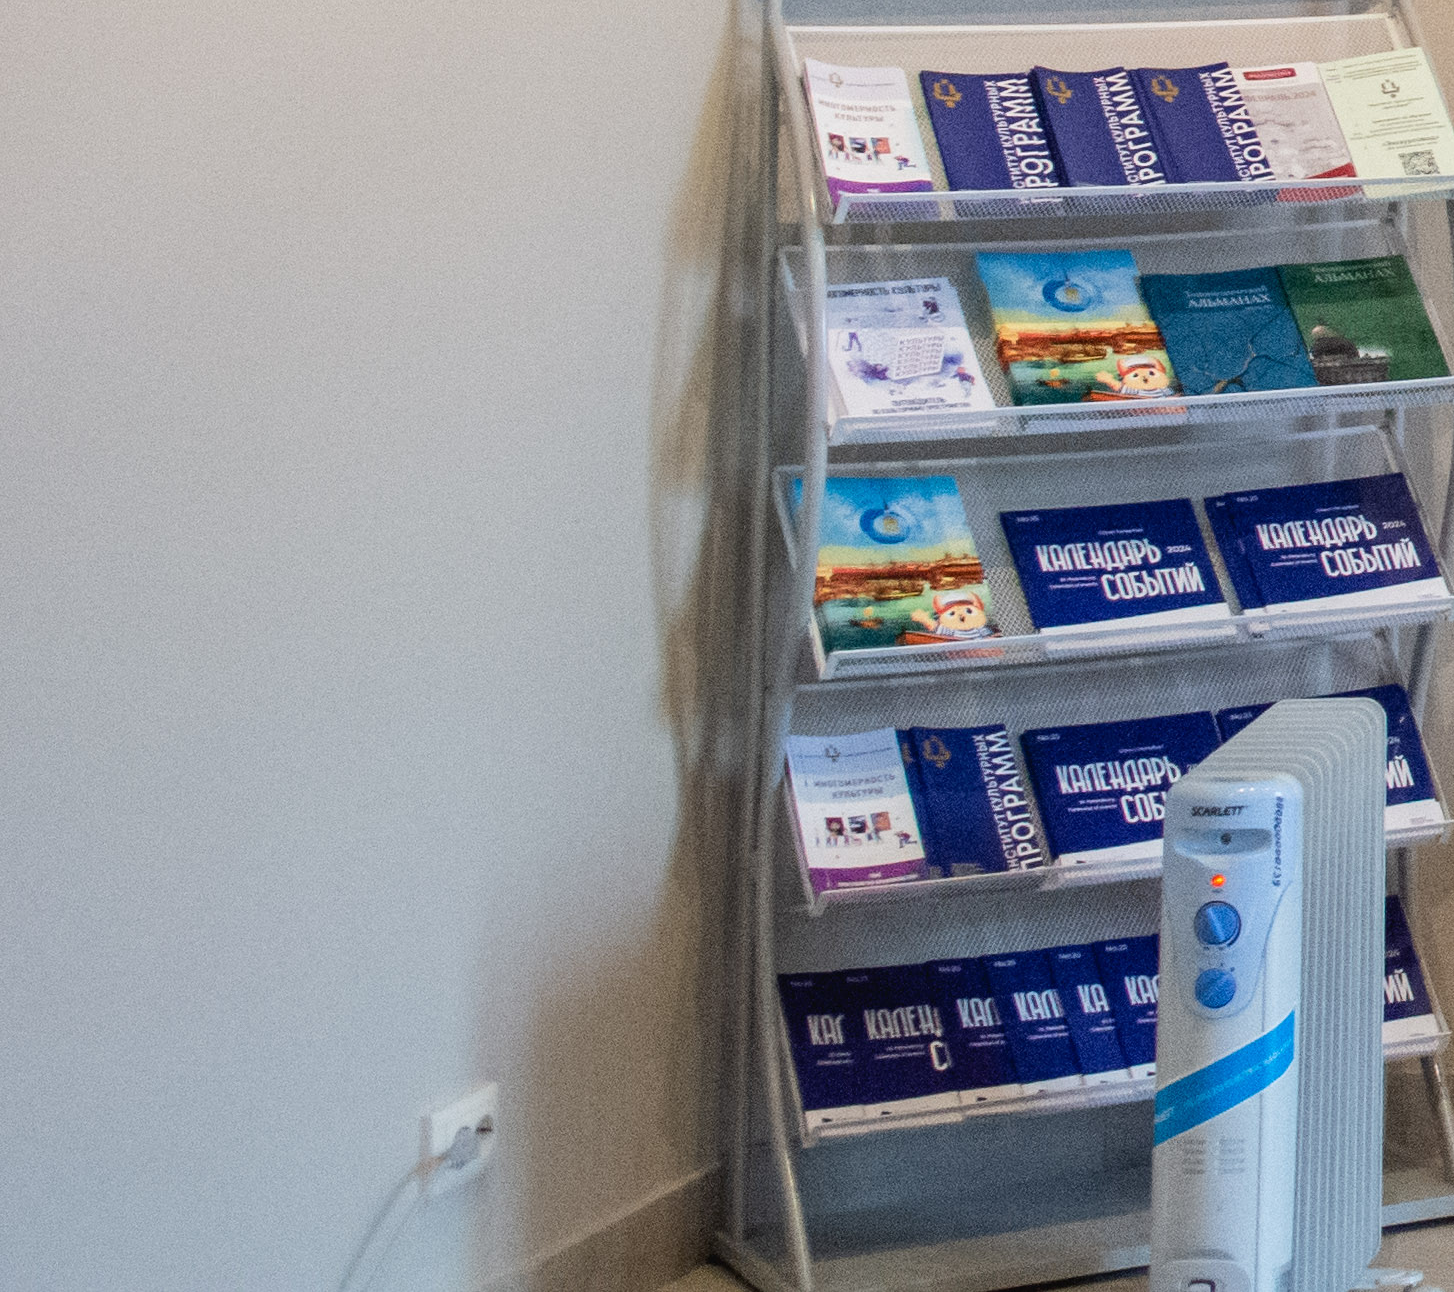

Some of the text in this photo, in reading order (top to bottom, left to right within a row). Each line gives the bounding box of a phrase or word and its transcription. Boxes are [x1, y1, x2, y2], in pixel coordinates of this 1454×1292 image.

[983, 79, 1013, 148] КУЛЬТУРНЫХ
[1093, 76, 1125, 143] КУЛЬТУРНЫХ
[1198, 72, 1233, 138] КУЛЬТУРНЫХ
[1188, 293, 1271, 308] АЛЬМАНАХ
[1255, 514, 1407, 551] КАЛЕНДАРЬ 2024
[1034, 538, 1193, 572] КАЛЕНДАРЬ 2024
[1319, 537, 1421, 577] СОБЫТИЙ
[1100, 561, 1205, 601] СОБЫТИЙ
[813, 773, 897, 788] МНОГОМЕРНОСТЬ
[972, 733, 1005, 812] КУЛЬТУРНЫХ
[1056, 755, 1182, 794] КАЛЕНДАРЬ
[831, 786, 884, 799] КУЛЬТУРЫ
[1120, 791, 1166, 824] СОБ
[1190, 805, 1247, 817] SCARLETT
